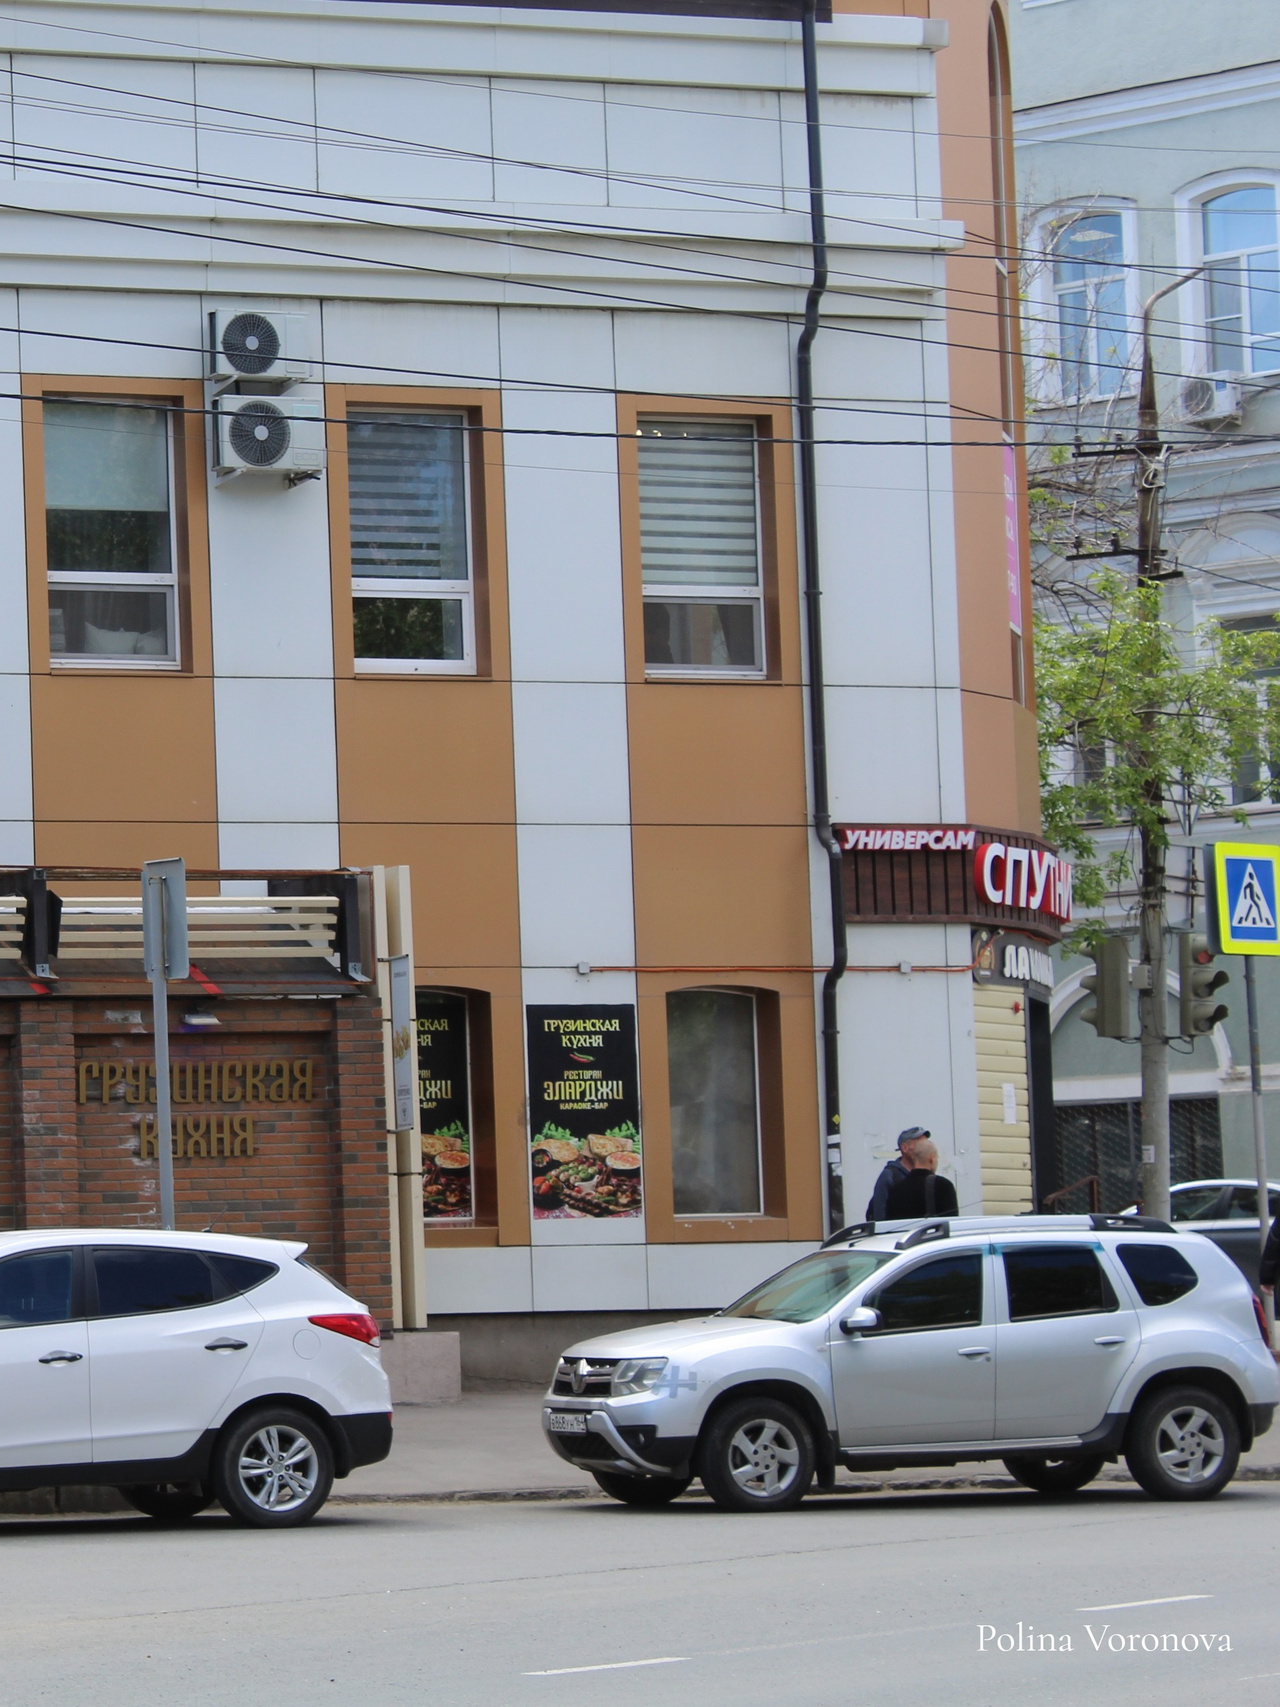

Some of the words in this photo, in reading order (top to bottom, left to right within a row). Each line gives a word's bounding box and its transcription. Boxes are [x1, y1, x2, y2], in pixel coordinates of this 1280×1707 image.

[844, 830, 976, 850] УНИВЕРСАМ
[543, 1019, 621, 1033] ГРУЗИНСКАЯ
[561, 1035, 604, 1048] КУХНЯ
[563, 1070, 602, 1080] РЕСТОРАН
[543, 1080, 624, 1101] ЭЛАРДЖИ
[559, 1102, 609, 1110] КАРАОКЕ-БАР
